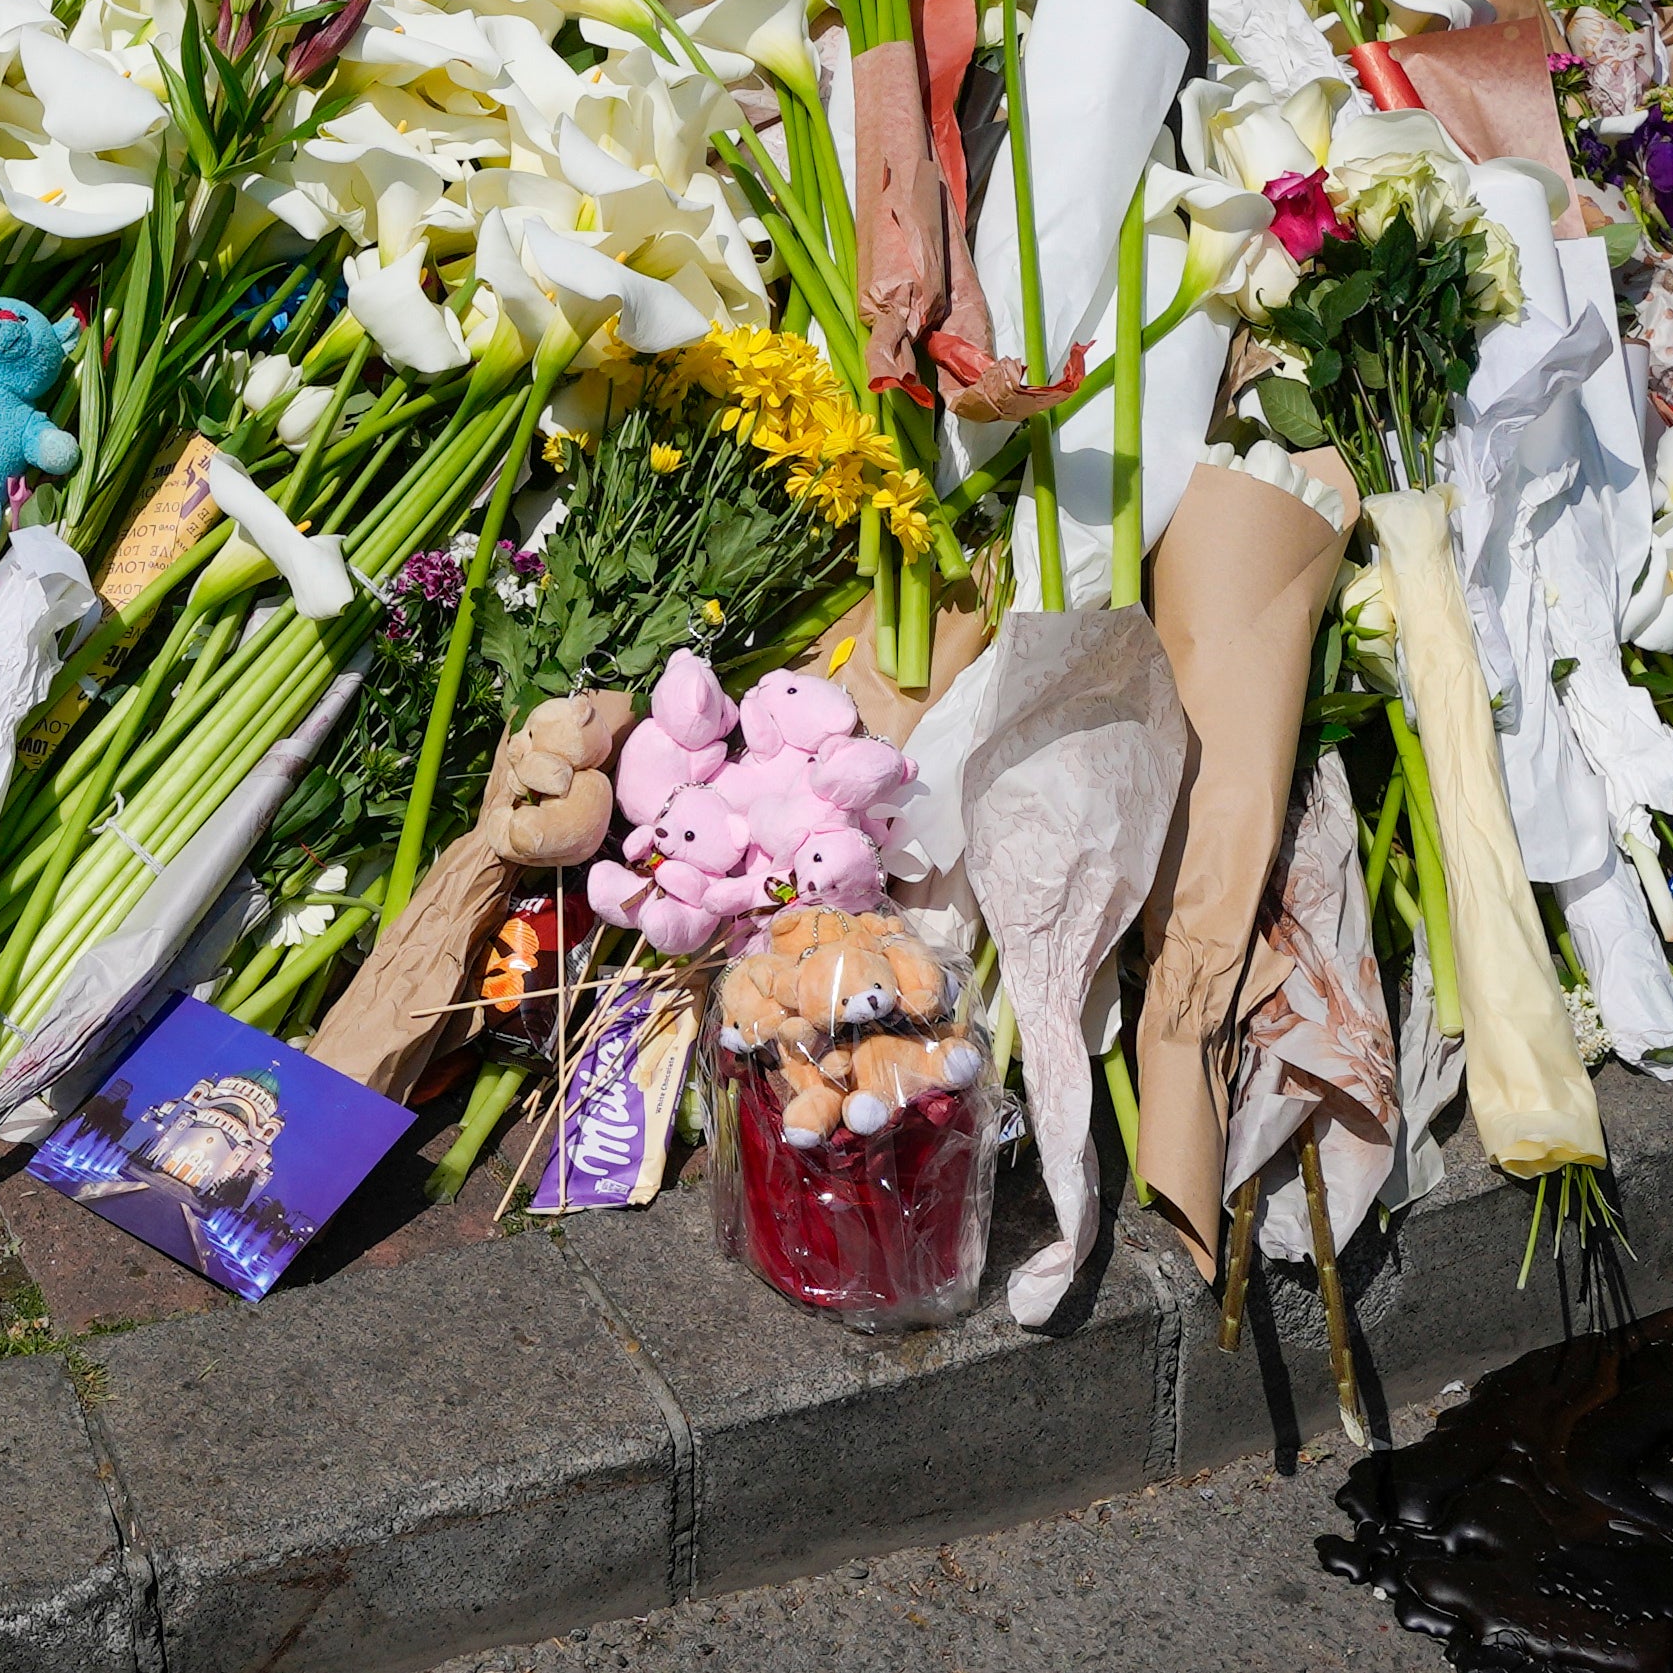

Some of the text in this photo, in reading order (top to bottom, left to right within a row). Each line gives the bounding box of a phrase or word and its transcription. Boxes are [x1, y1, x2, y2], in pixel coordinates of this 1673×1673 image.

[154, 502, 181, 513] OVE
[106, 561, 146, 574] LOVE
[105, 583, 143, 595] LOVE
[654, 1055, 676, 1115] White Chocolate
[568, 1036, 639, 1176] Milka
